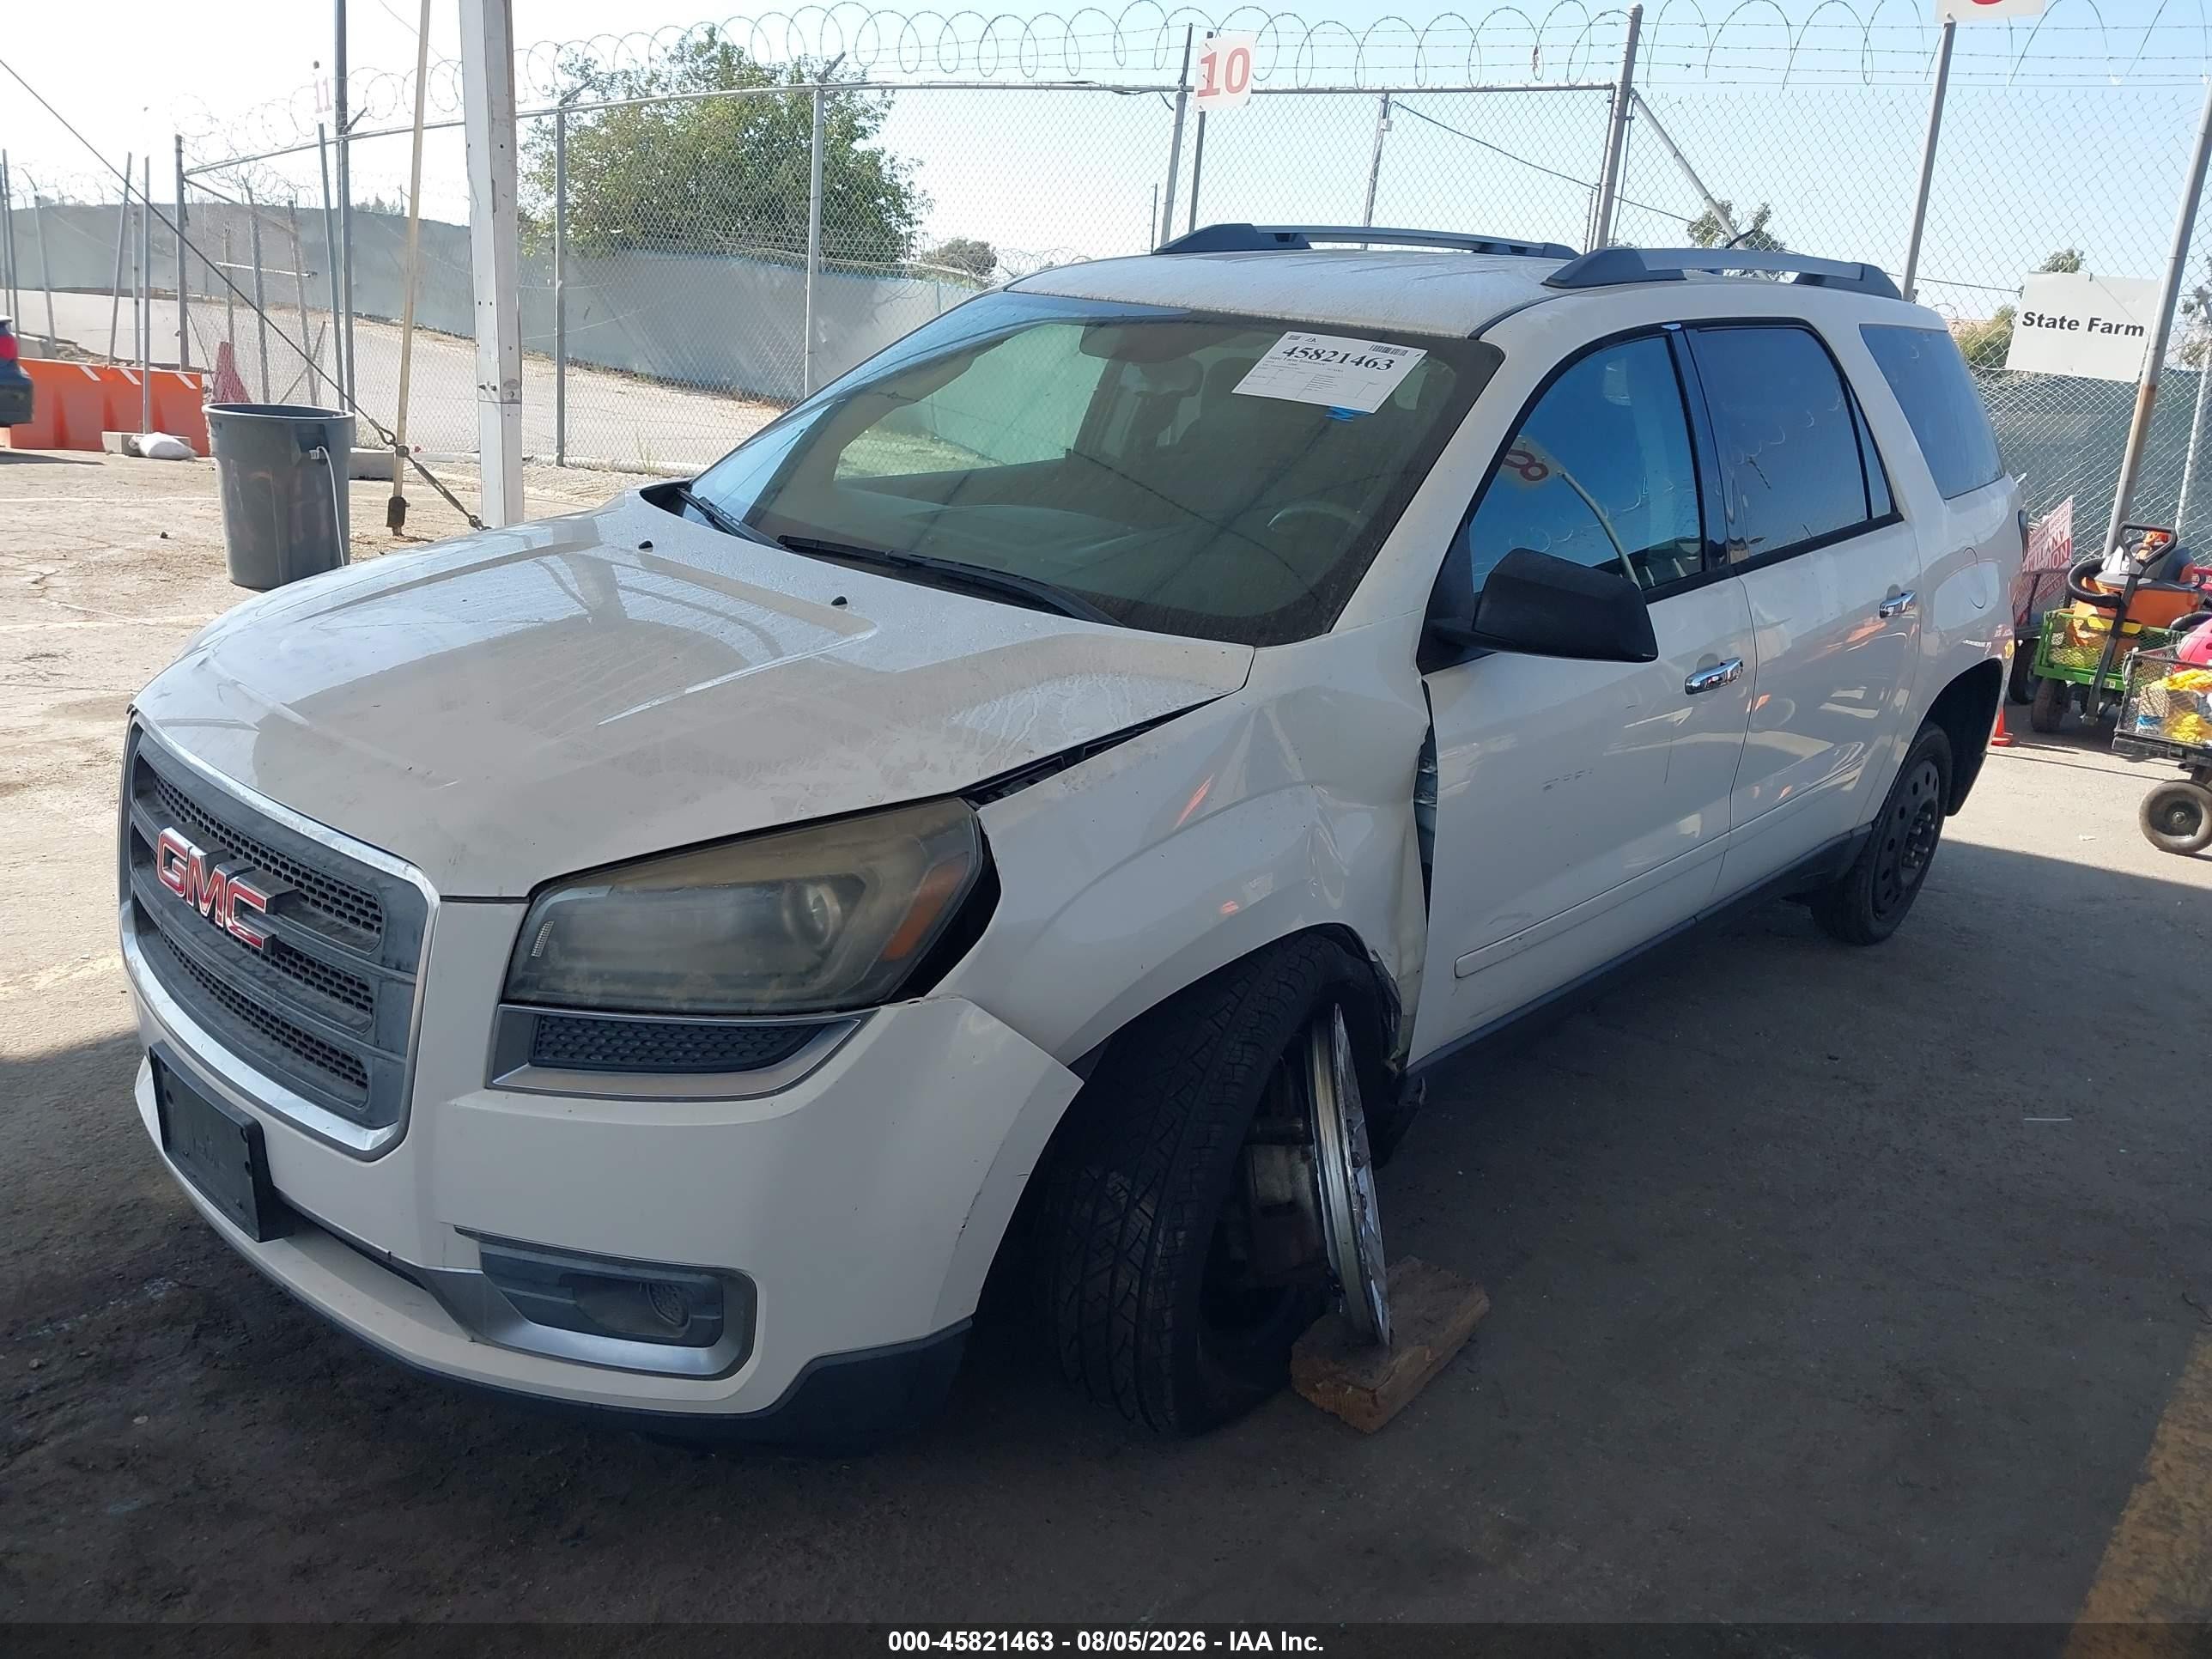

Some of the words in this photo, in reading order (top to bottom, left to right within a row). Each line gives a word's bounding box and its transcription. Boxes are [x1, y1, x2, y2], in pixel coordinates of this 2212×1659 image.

[1197, 47, 1251, 97] 10
[314, 76, 332, 113] 11
[2022, 311, 2080, 331] State
[2087, 317, 2145, 337] Farm
[1282, 345, 1395, 371] 45821463
[2051, 541, 2068, 568] NO
[157, 827, 268, 950] GMC
